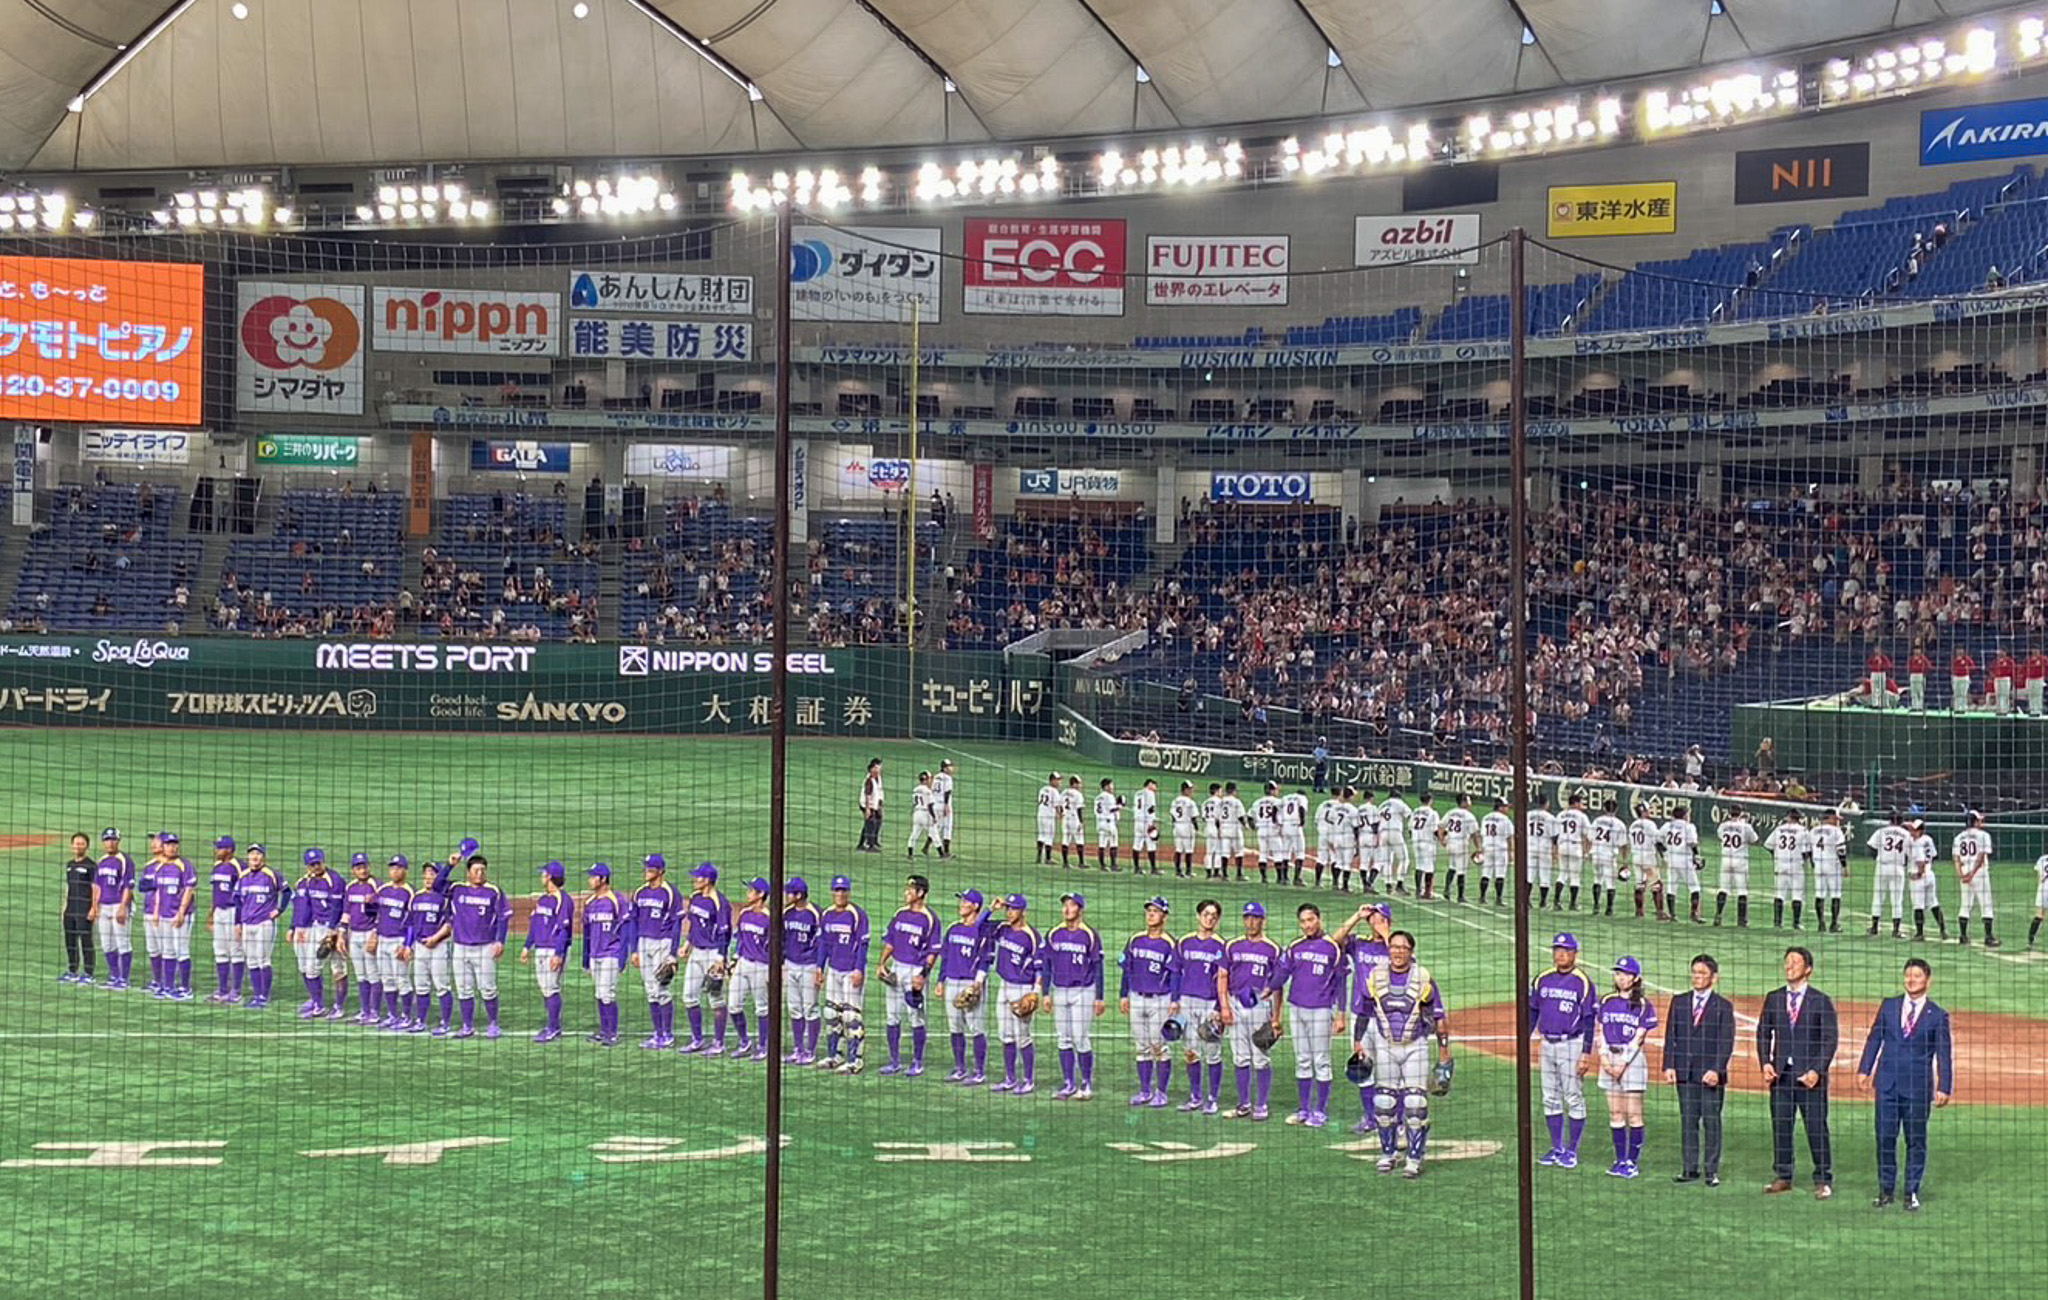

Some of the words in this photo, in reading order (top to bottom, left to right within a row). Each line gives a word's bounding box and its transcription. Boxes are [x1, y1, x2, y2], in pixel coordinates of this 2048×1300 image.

[1576, 196, 1671, 221] 東洋水産
[1381, 219, 1455, 245] azbil
[983, 239, 1105, 282] ECC
[1152, 244, 1285, 275] FUJITEC
[1369, 247, 1463, 262] アズビル株式会社
[839, 249, 934, 279] ダイダン
[600, 274, 750, 303] あんしん財団
[1153, 282, 1282, 298] 世界のエレベータ
[386, 291, 548, 342] nippn
[499, 338, 548, 352] ニップン
[574, 320, 746, 359] 能美防災
[1181, 351, 1255, 367] DUSKIN
[1265, 350, 1339, 366] DUSKIN
[254, 375, 345, 400] シマダヤ
[86, 431, 188, 451] ニッテイライフ
[1027, 476, 1051, 489] JR
[1060, 475, 1119, 492] JR貨物
[1215, 474, 1307, 497] TOTO
[316, 643, 439, 670] MEETS
[446, 645, 537, 672] PORT
[653, 651, 748, 672] NIPPON
[754, 651, 835, 673] SEEL
[167, 690, 347, 716] プロ野球スピリッツA
[430, 694, 462, 705] Good
[496, 690, 626, 722] SANKYO
[430, 706, 462, 717] Good
[702, 694, 873, 726] 大和証券
[1163, 749, 1211, 774] ウエルシア
[1334, 763, 1412, 788] トンボ鉛筆
[1451, 771, 1503, 801] MEETS
[1503, 777, 1542, 804] PRT
[1414, 816, 1427, 830] 27
[1448, 818, 1462, 833] 28
[1485, 822, 1497, 837] 18
[1528, 822, 1545, 837] 15
[1561, 819, 1577, 834] 19
[1595, 826, 1611, 842] 24
[1631, 830, 1646, 845] 10
[1667, 830, 1683, 846] 26
[1722, 833, 1742, 849] 20
[1815, 836, 1825, 851] 4
[1884, 837, 1904, 853] 34
[1203, 962, 1211, 974] 7
[1251, 963, 1265, 977] 21
